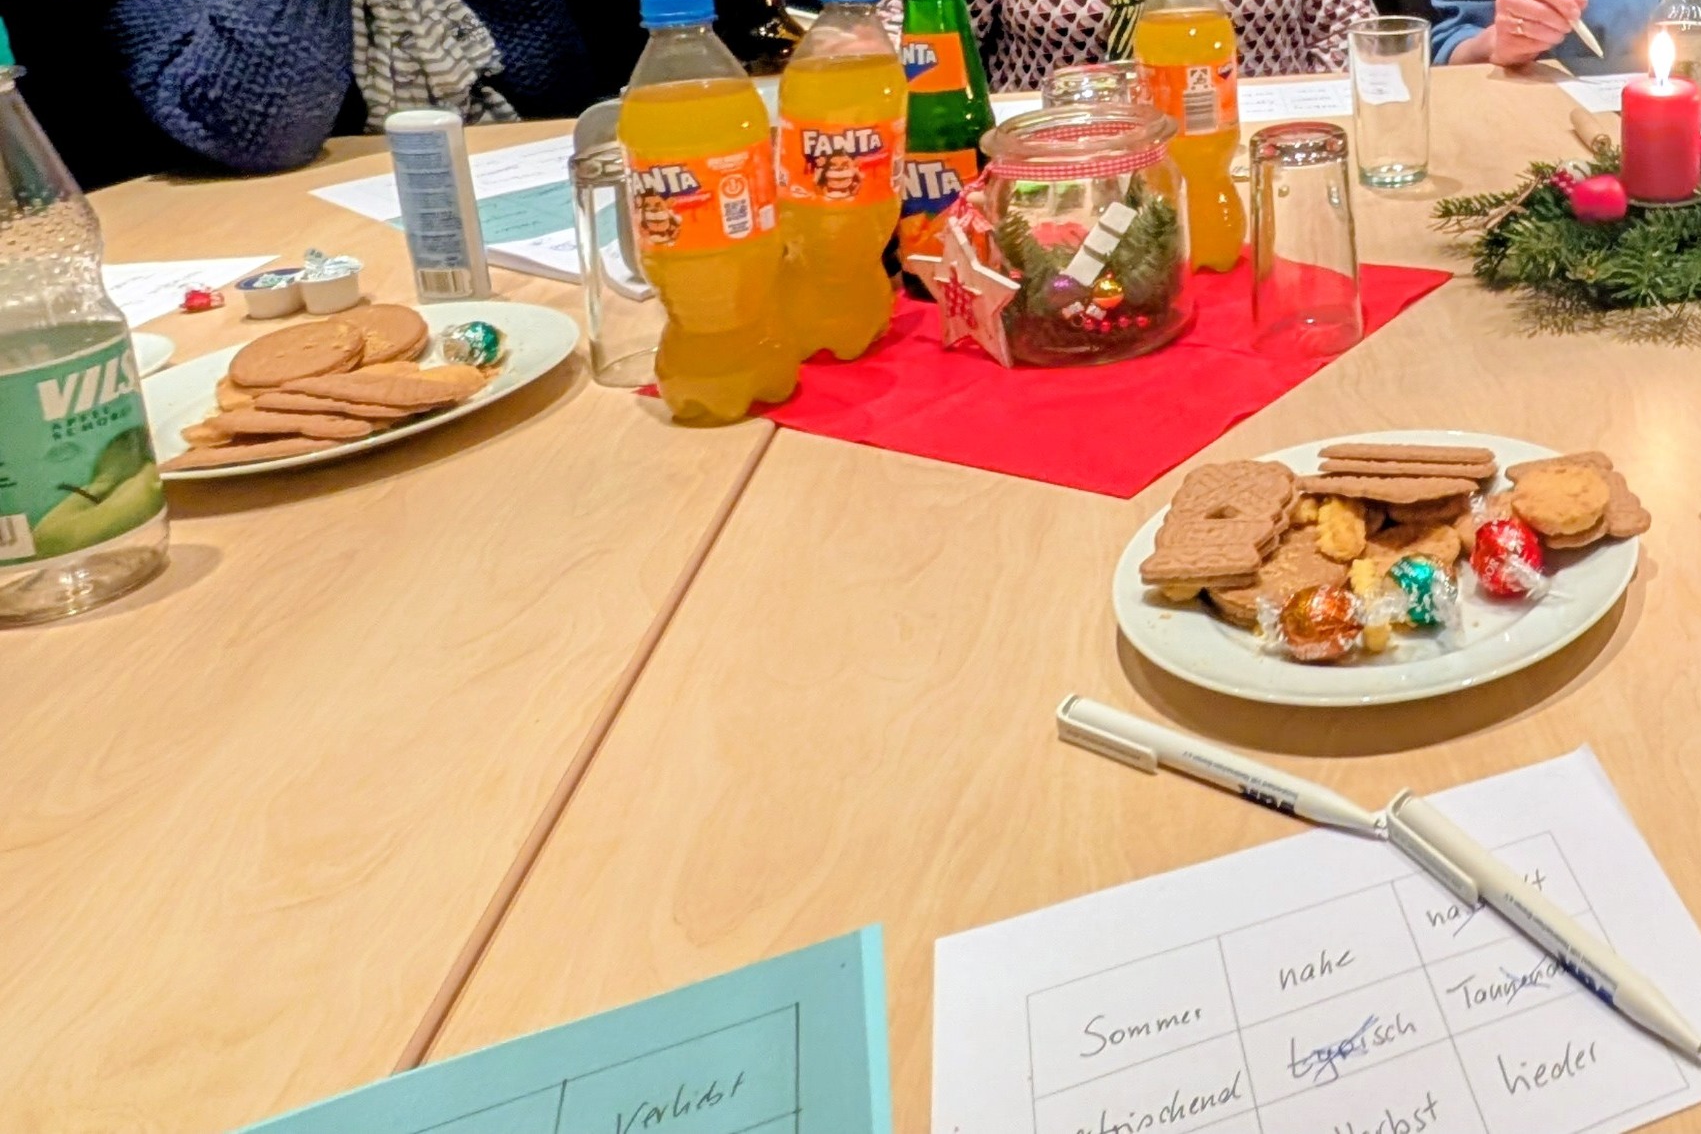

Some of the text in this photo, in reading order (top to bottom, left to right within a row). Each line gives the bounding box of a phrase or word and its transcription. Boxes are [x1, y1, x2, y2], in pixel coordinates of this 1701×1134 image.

[902, 43, 937, 66] NTA
[802, 129, 881, 157] FANTA
[631, 165, 699, 196] ANTA
[902, 162, 963, 200] NTA
[37, 349, 140, 421] VILS
[1279, 948, 1356, 991] nahe
[1079, 1008, 1203, 1058] Sommer
